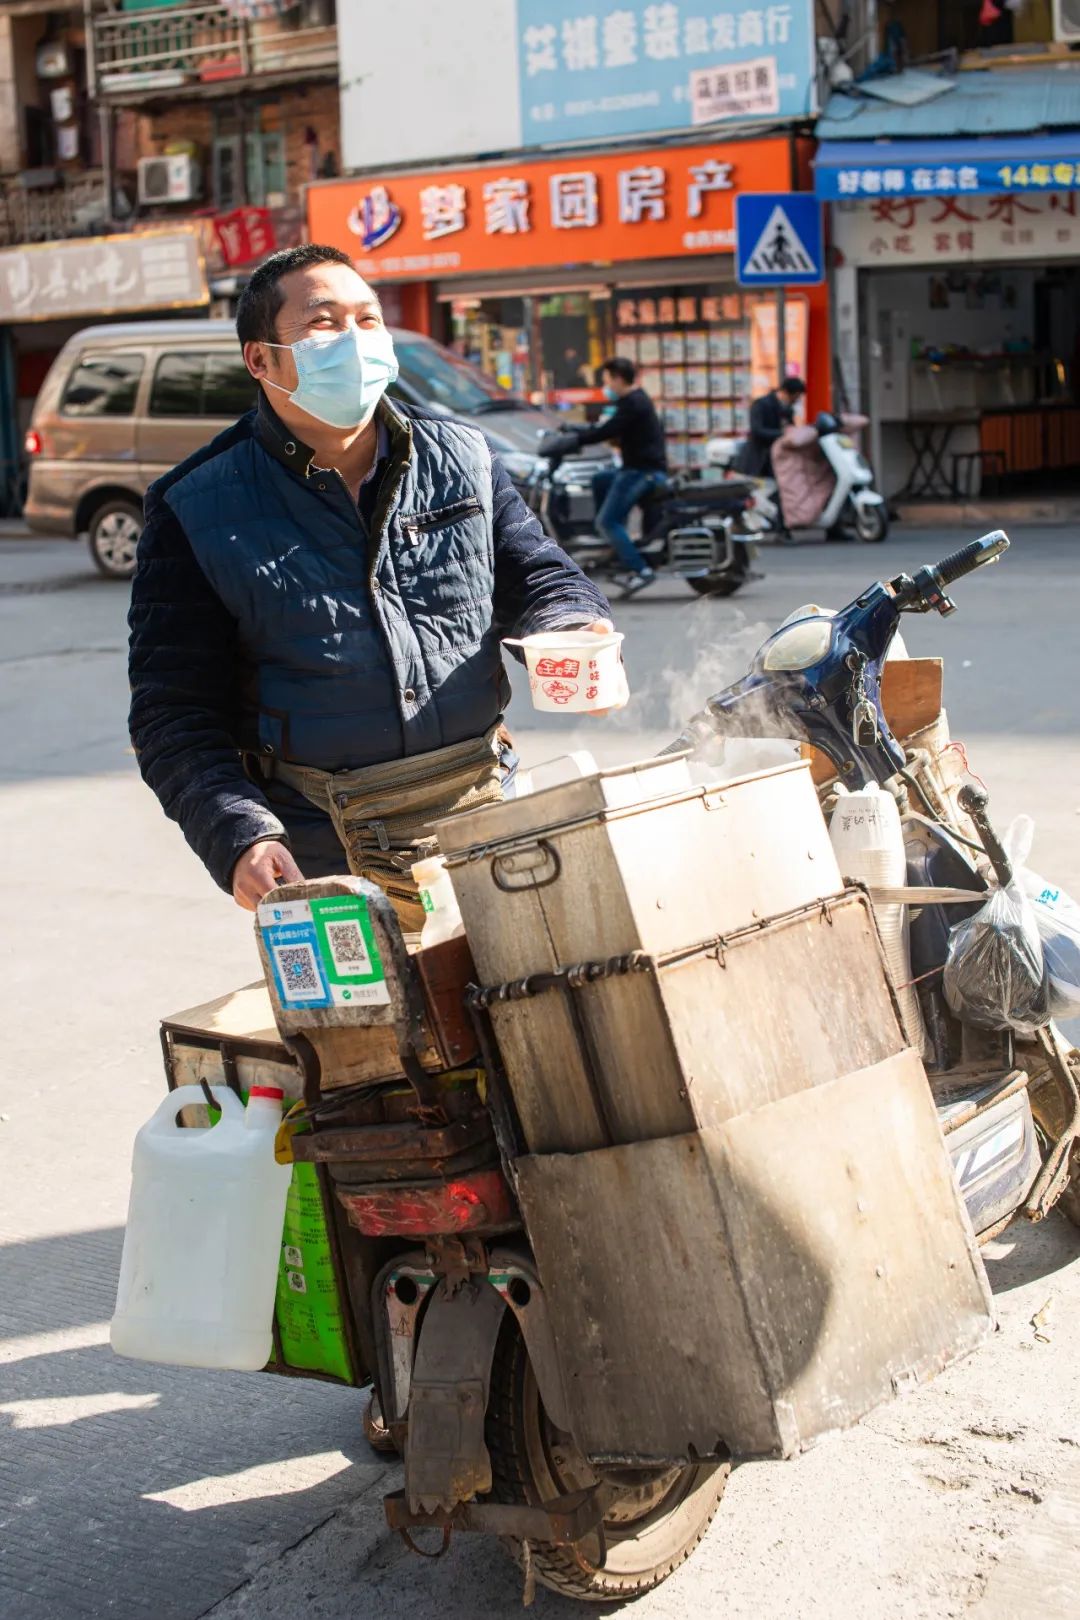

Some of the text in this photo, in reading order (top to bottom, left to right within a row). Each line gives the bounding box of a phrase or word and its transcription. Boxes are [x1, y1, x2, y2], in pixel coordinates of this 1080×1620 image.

[419, 160, 734, 240] 梦家园房产
